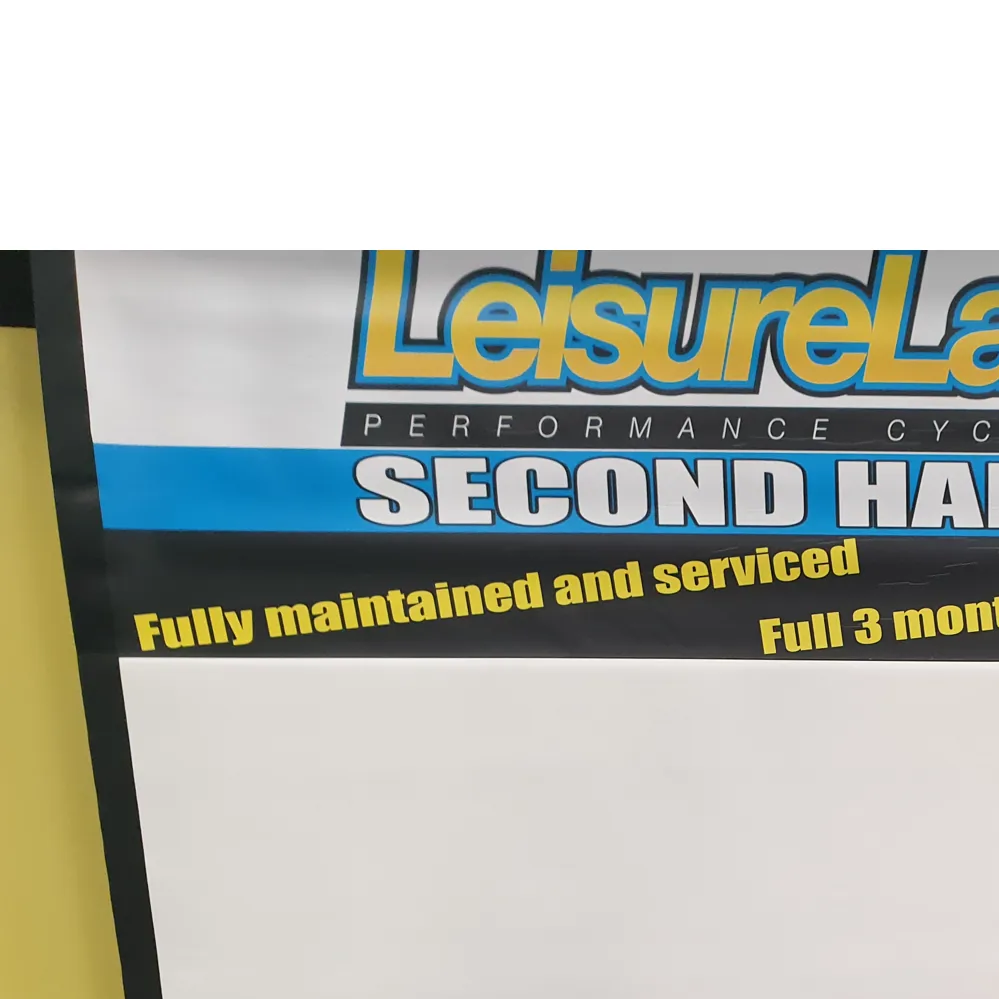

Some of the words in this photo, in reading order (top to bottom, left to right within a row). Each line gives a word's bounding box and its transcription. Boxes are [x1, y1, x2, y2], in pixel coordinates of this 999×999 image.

[363, 412, 830, 442] PERFORMANCE
[354, 454, 808, 528] SECOND
[133, 606, 254, 652] Fully
[264, 571, 544, 638] maintained
[553, 560, 644, 606] and
[652, 537, 860, 595] serviced
[759, 611, 844, 655] Full
[852, 607, 883, 645] 3
